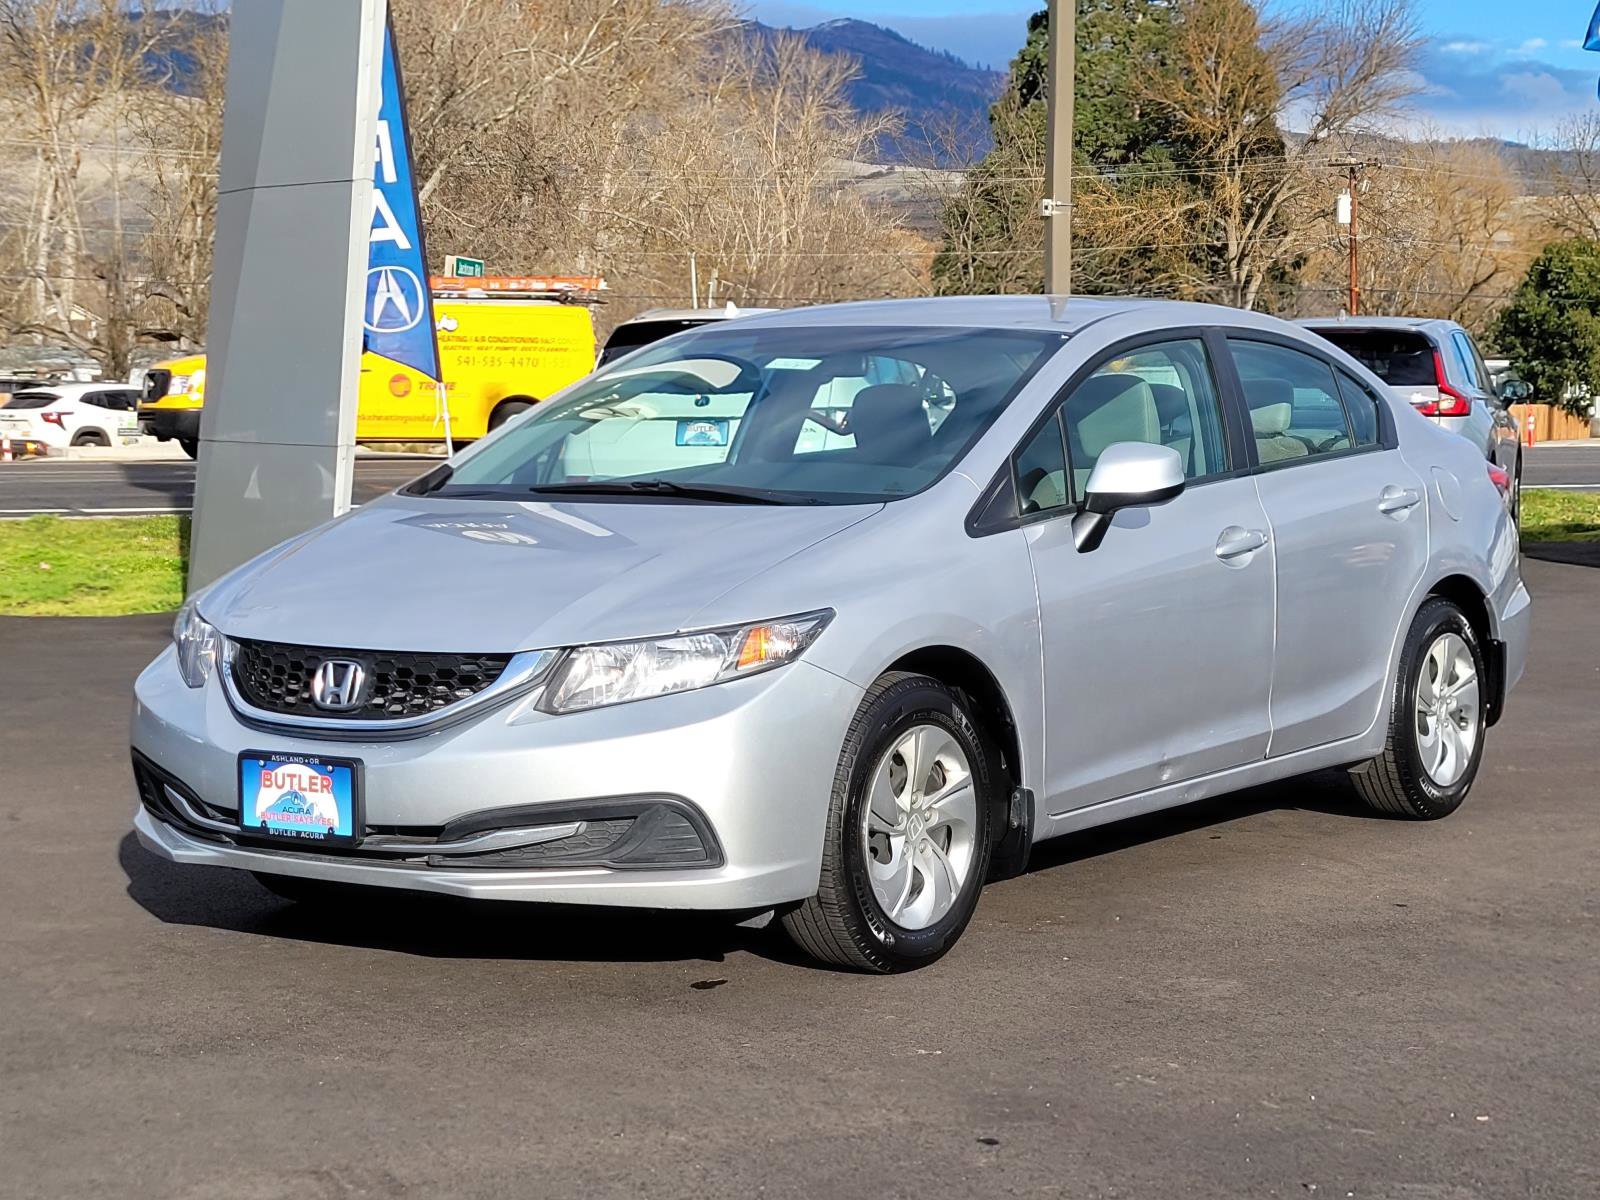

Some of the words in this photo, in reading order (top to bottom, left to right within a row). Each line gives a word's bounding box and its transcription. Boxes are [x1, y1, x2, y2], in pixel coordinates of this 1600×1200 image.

[271, 754, 304, 764] ASHLAND
[310, 757, 320, 765] OR
[261, 769, 333, 794] BUTLER
[282, 806, 312, 815] ACURA
[260, 811, 292, 823] BUTLER
[269, 828, 297, 838] BUTLER
[300, 830, 325, 840] ACURA
